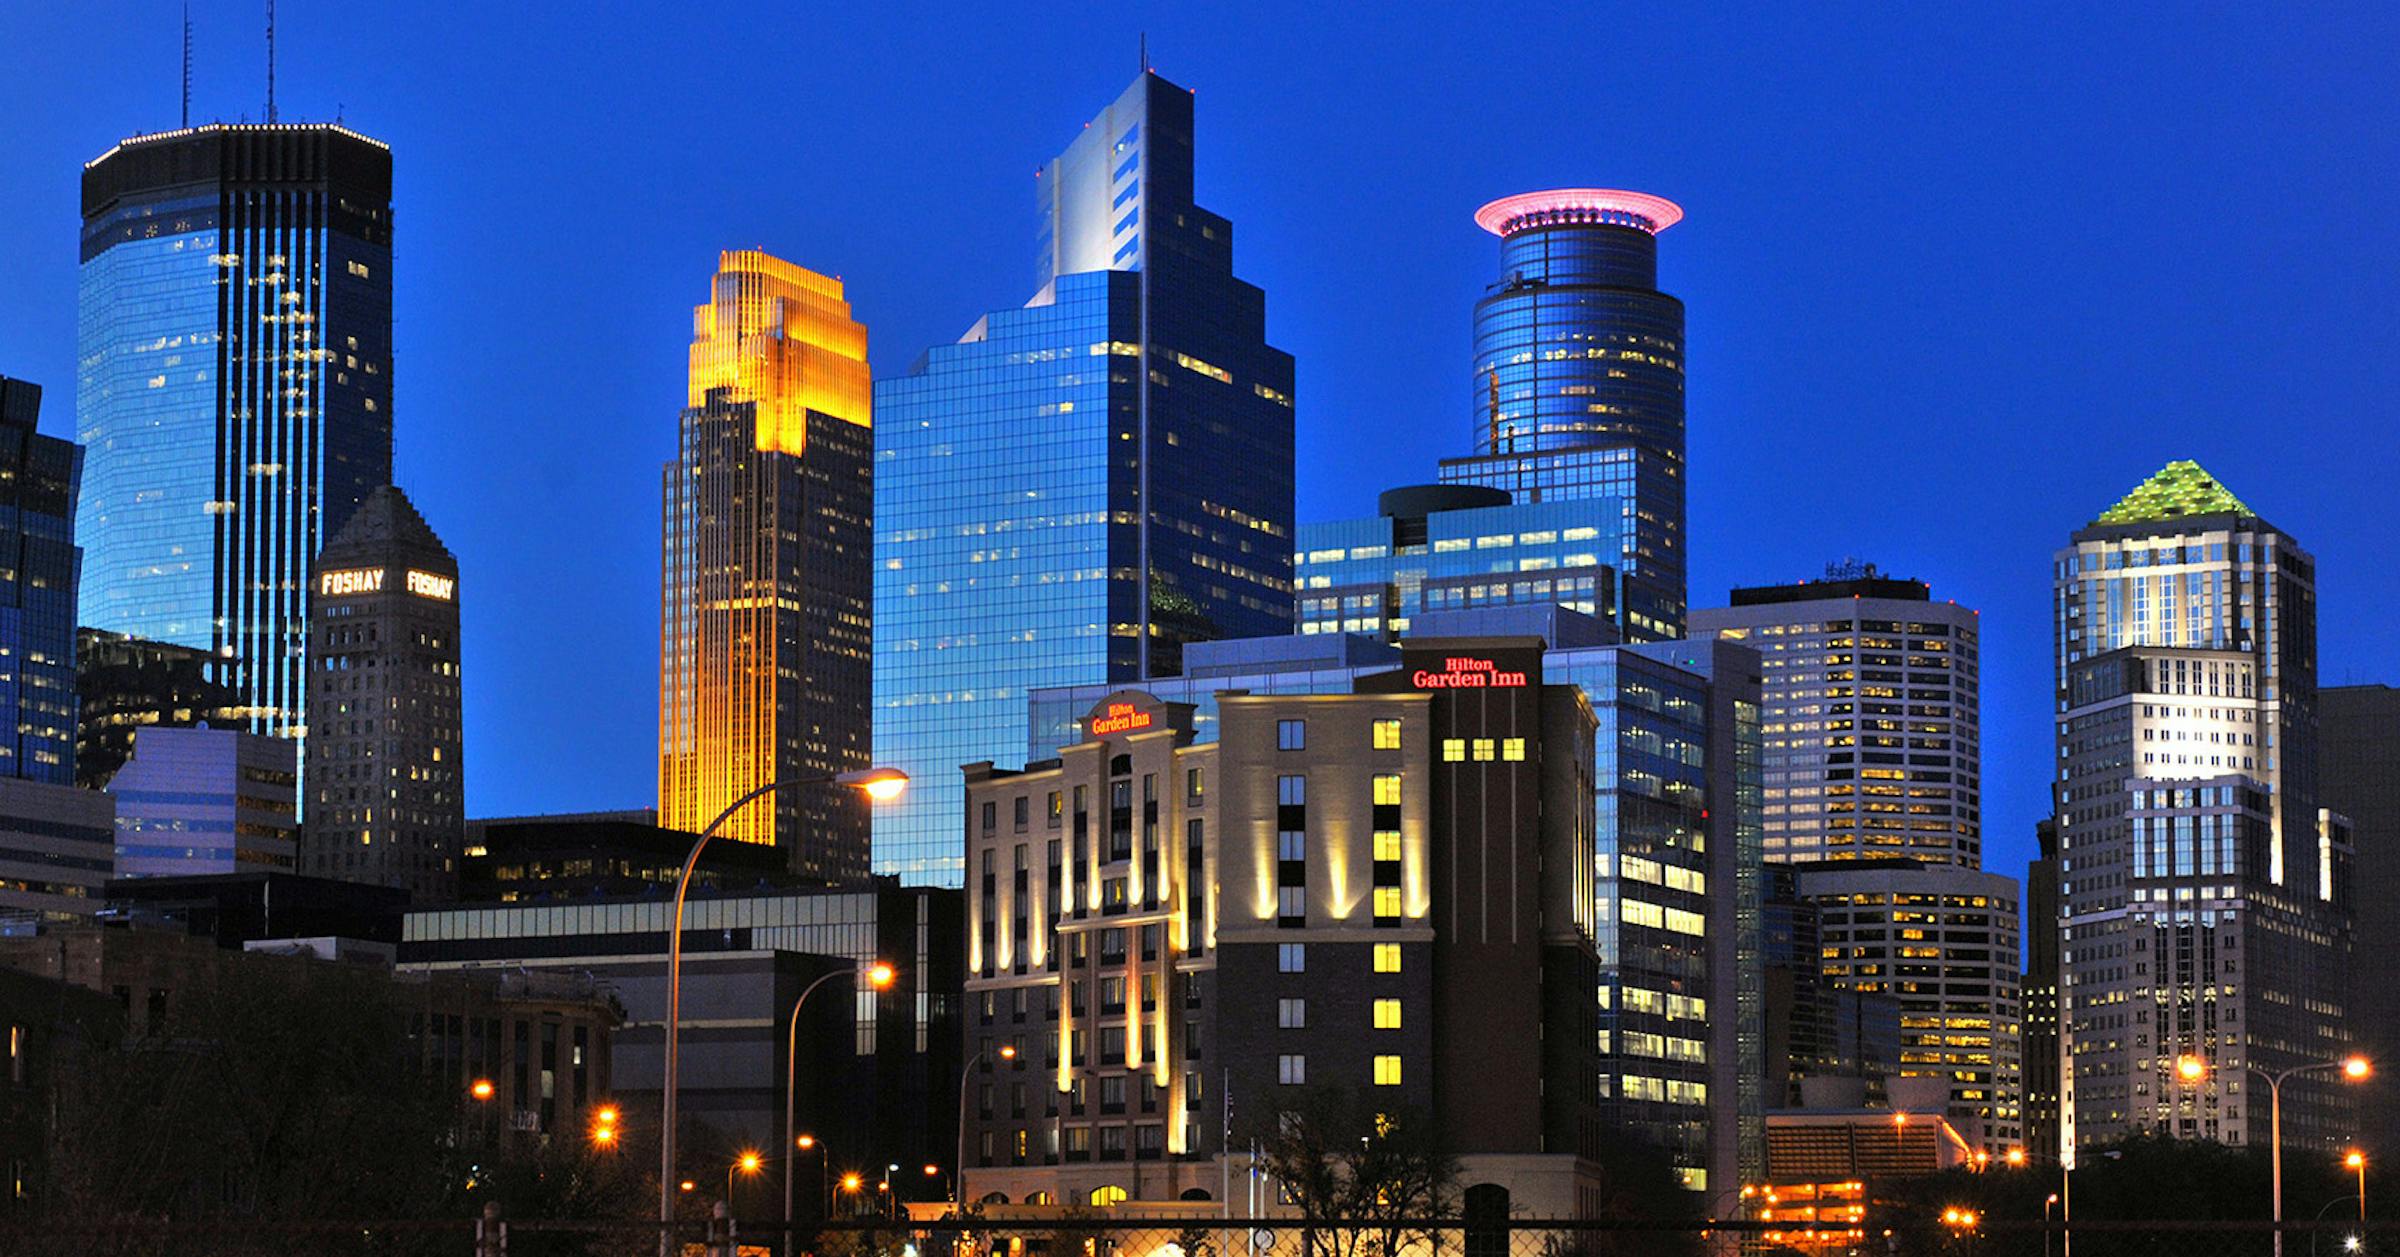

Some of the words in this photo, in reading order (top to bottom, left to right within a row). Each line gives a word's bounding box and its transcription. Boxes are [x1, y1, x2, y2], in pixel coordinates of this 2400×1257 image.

[321, 569, 384, 595] FOSHAY
[407, 570, 453, 600] FOSHAY
[1445, 657, 1494, 671] Hilton
[1413, 670, 1486, 688] Garden
[1490, 669, 1527, 687] Inn
[1108, 704, 1134, 717] Hilton
[1092, 716, 1130, 735] Garden
[1131, 712, 1151, 728] Inn
